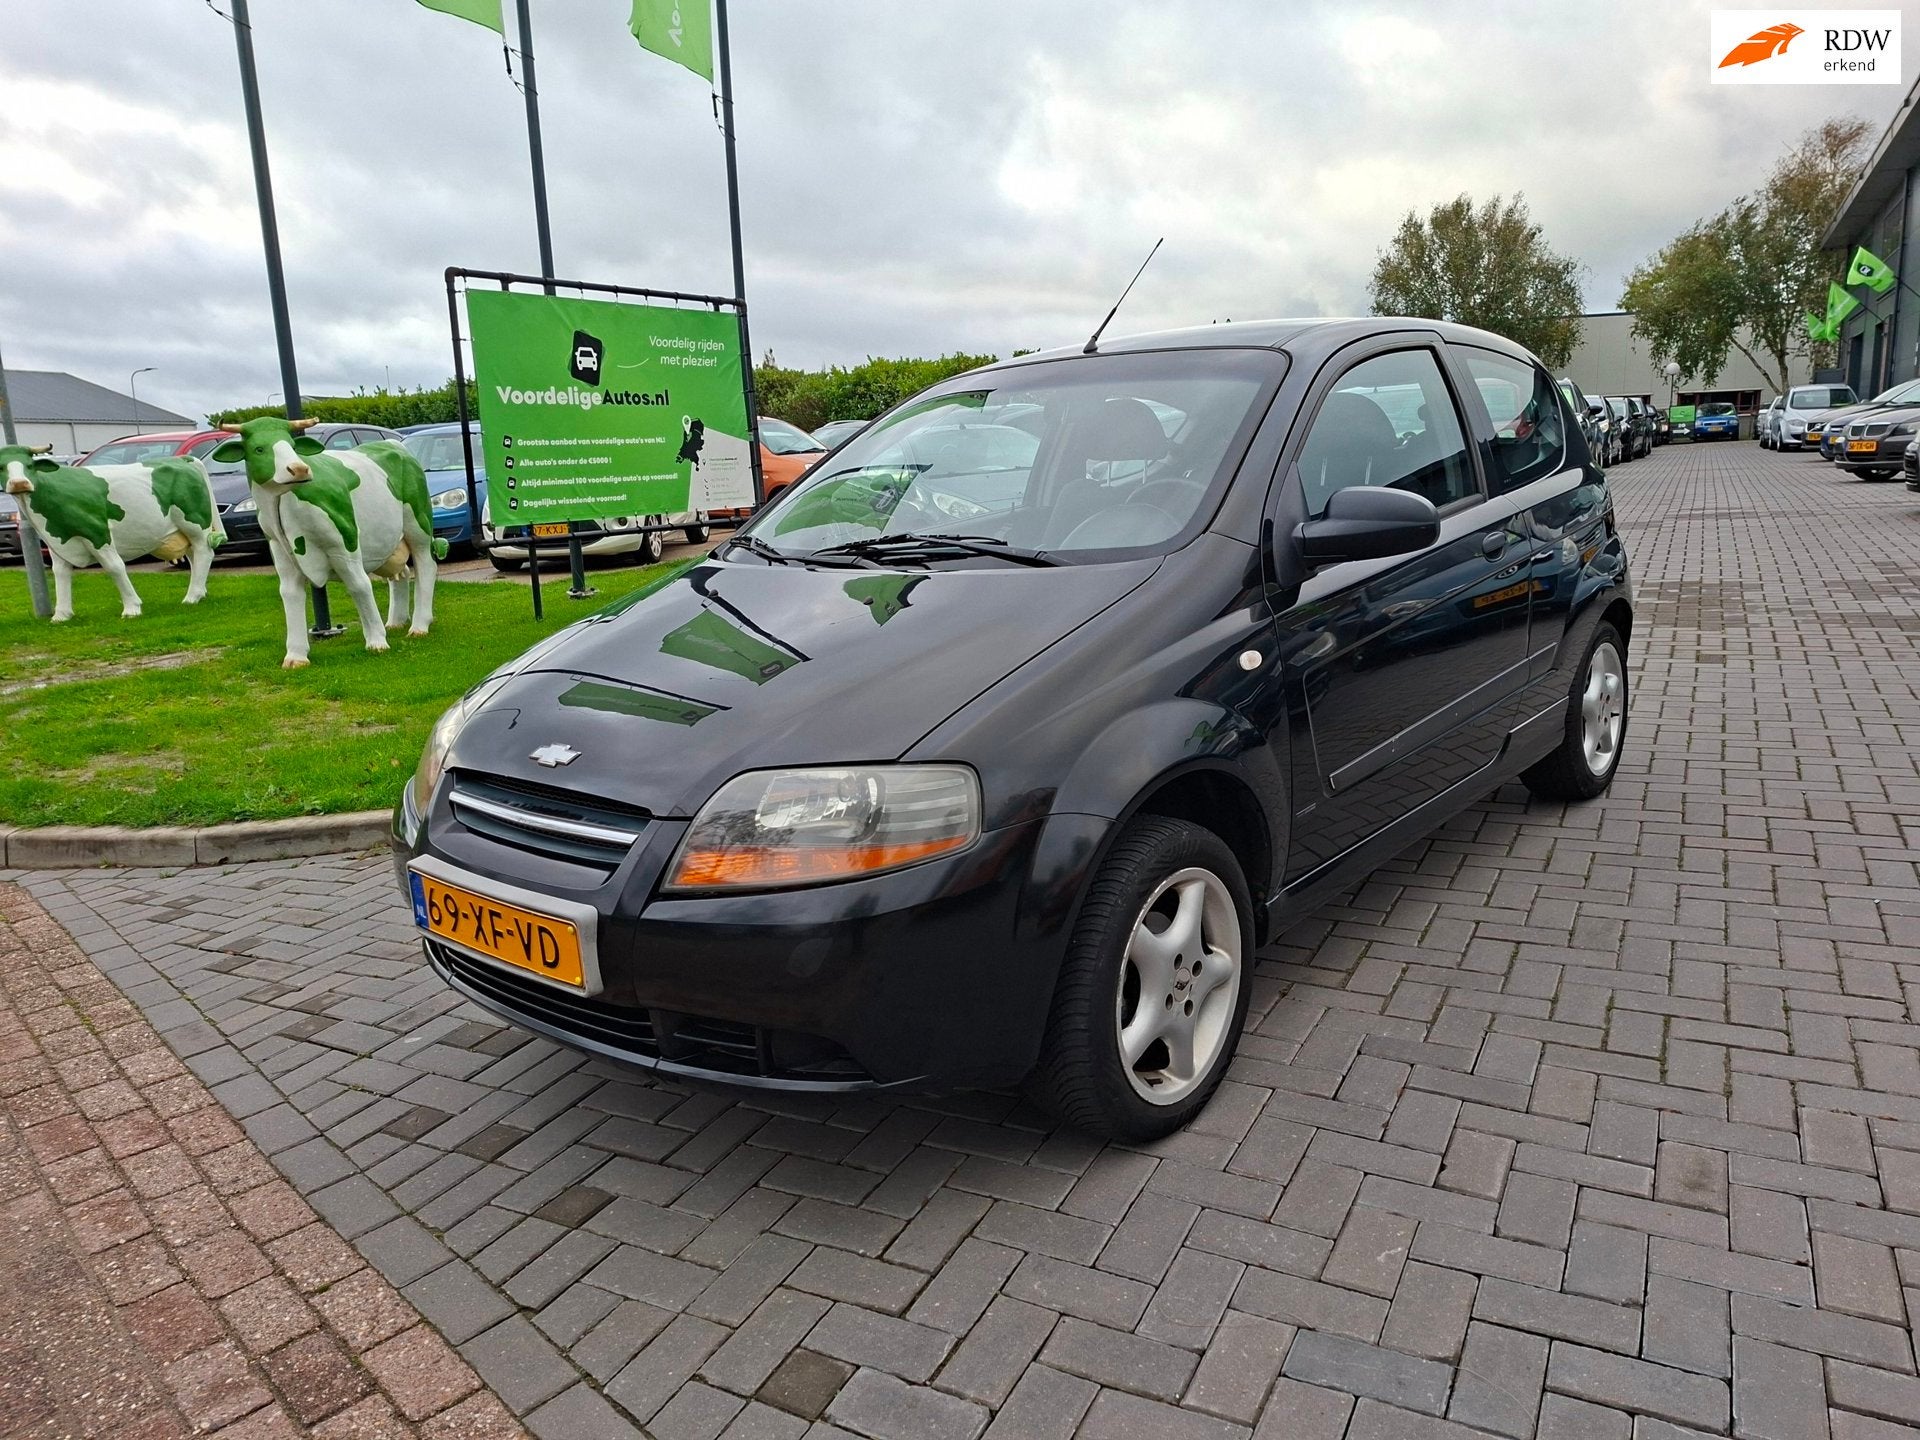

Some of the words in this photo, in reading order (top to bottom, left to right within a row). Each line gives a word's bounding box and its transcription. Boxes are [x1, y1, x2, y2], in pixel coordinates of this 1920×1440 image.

[649, 335, 696, 352] Voordelig
[698, 339, 725, 353] rijden
[660, 355, 680, 366] met
[682, 354, 717, 368] plezier!
[496, 386, 669, 410] VoordeligeAutos.nl
[517, 438, 549, 446] Grootste
[550, 437, 577, 446] aanbod
[591, 436, 625, 446] voordelige
[625, 436, 644, 444] auto's
[520, 458, 534, 467] Alle
[535, 458, 557, 466] auto's
[558, 457, 578, 465] onder
[521, 479, 541, 488] Altijd
[542, 477, 575, 486] minimaal
[588, 475, 622, 484] voordelige
[622, 474, 642, 482] auto's
[523, 498, 557, 508] Dagelijks
[558, 496, 595, 505] wisselende
[597, 493, 627, 502] voorraad!
[429, 888, 560, 969] 69-XF-VD
